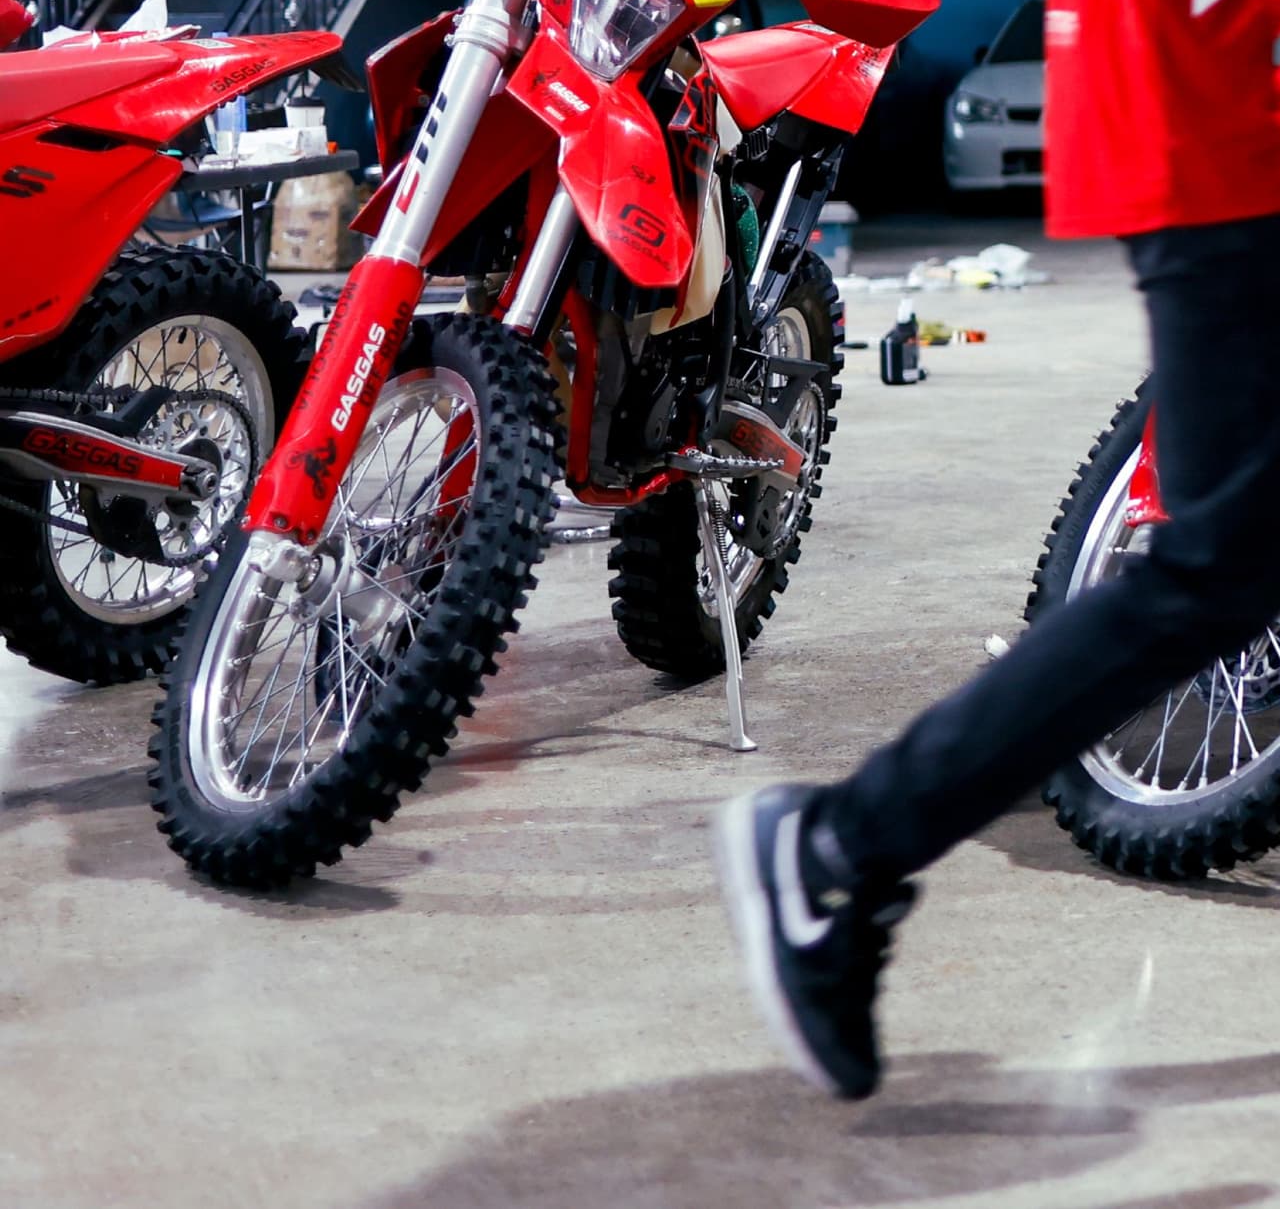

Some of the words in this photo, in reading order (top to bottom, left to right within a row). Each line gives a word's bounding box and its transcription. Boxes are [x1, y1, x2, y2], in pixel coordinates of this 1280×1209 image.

[210, 55, 277, 94] GASGAS
[331, 322, 387, 433] GASGAS
[22, 427, 144, 475] GASGAS
